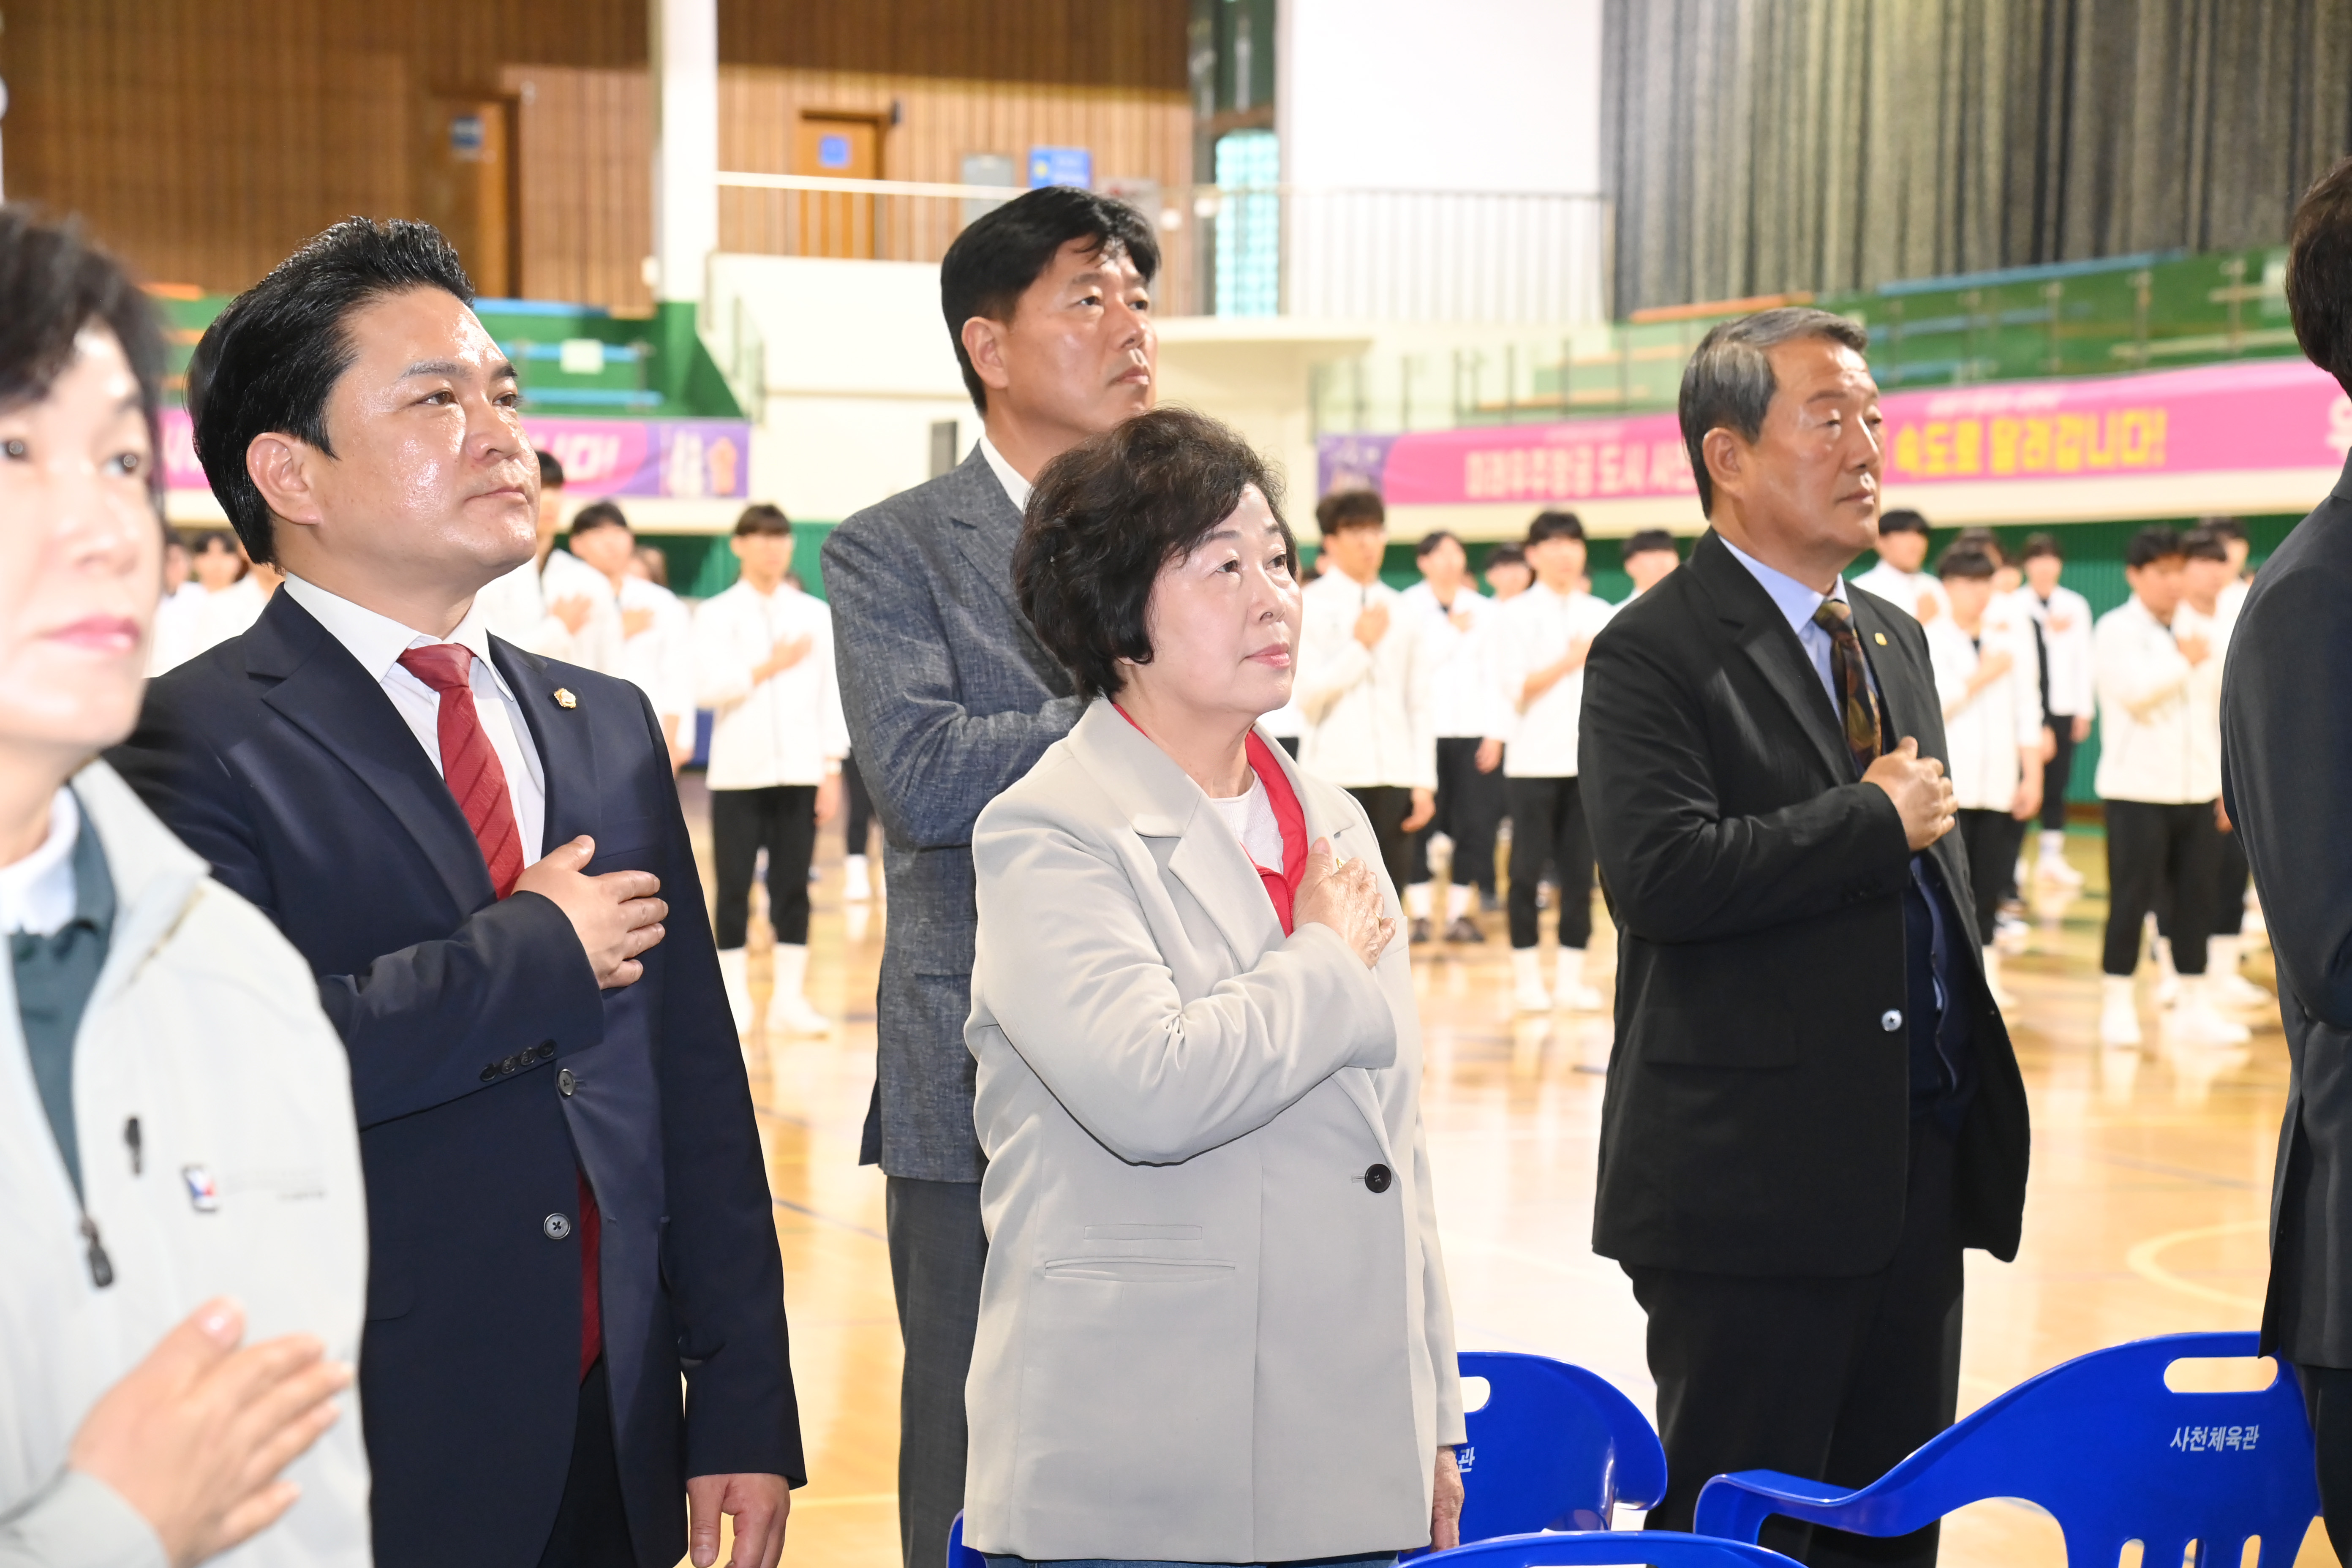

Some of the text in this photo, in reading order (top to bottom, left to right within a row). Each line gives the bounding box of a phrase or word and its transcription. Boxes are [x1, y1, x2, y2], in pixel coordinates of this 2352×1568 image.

[1895, 421, 1982, 478] 속도로
[2170, 1424, 2259, 1452] 사천체육관
[1455, 1447, 1475, 1473] 관
